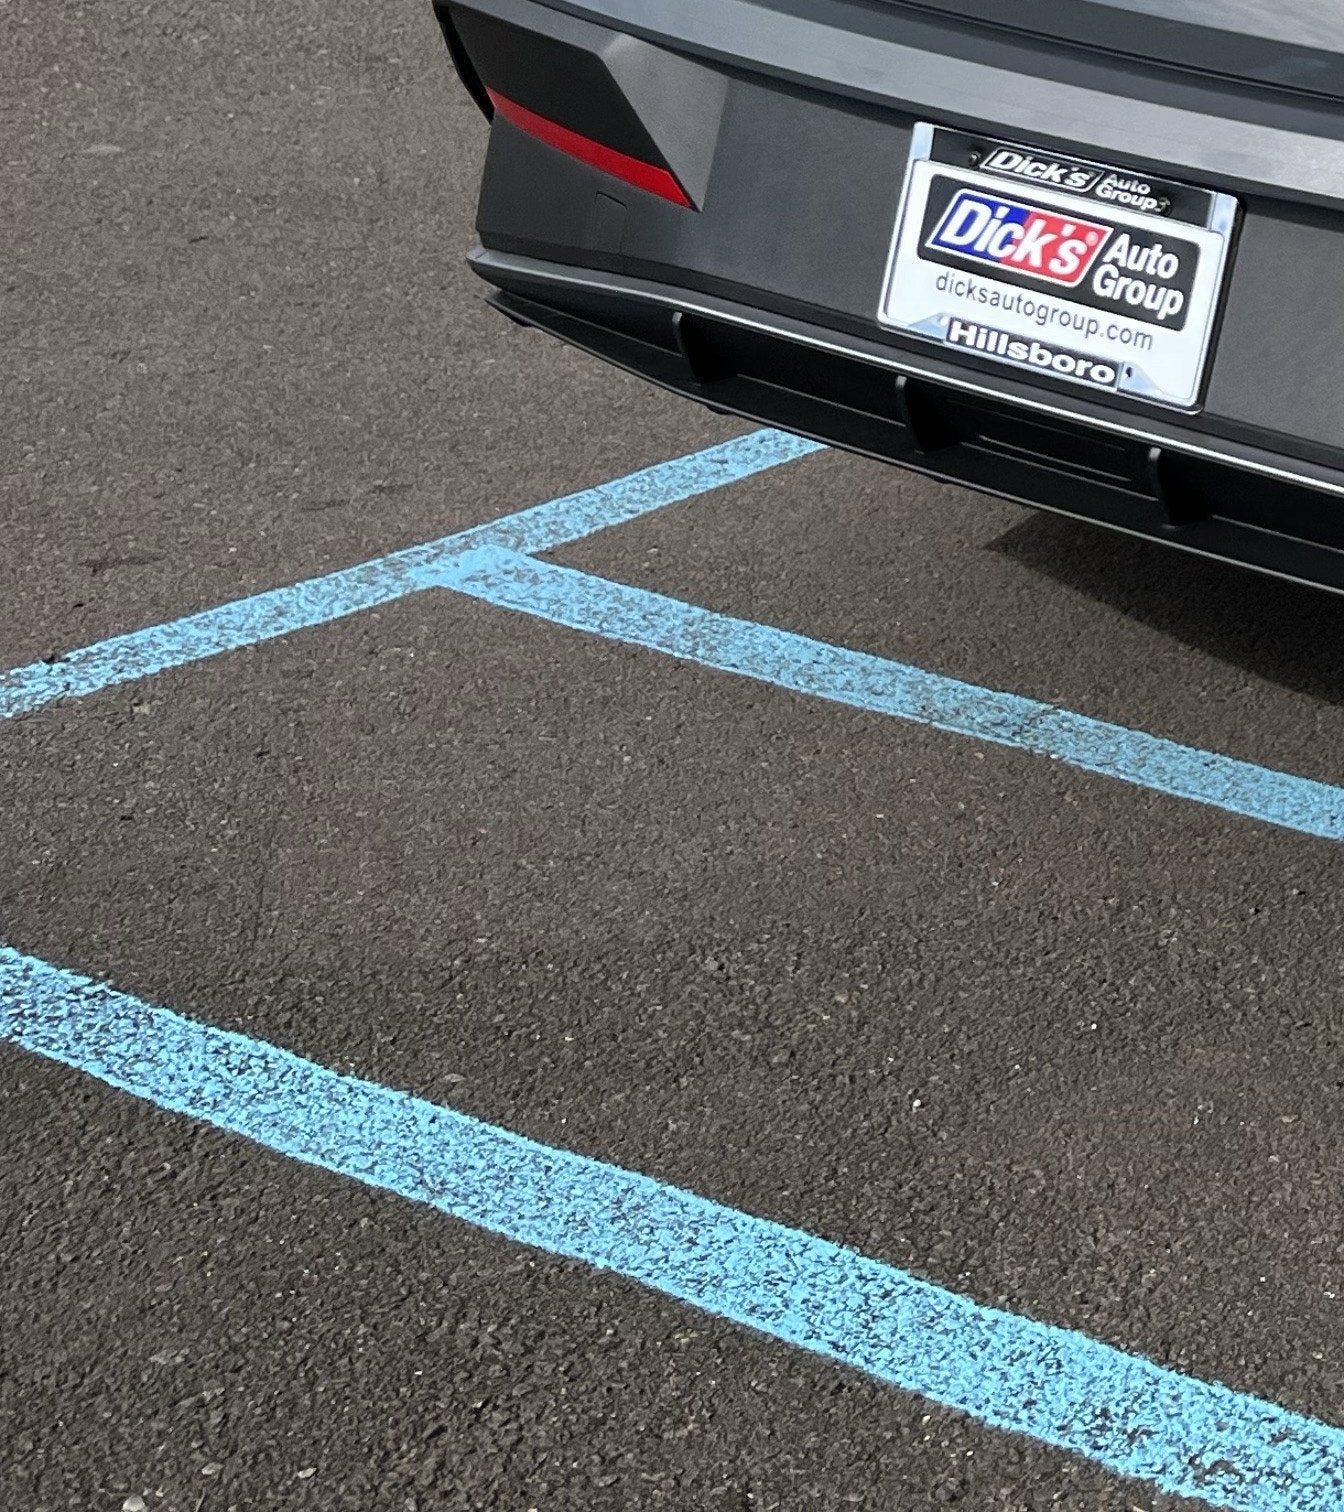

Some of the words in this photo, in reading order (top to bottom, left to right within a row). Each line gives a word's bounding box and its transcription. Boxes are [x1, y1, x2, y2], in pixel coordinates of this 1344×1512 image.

[986, 150, 1092, 189] Dick's
[1100, 172, 1151, 196] Auto
[1095, 183, 1158, 212] Group
[939, 198, 1089, 276] Dick's
[1102, 232, 1179, 280] Auto
[935, 272, 1154, 351] dicksautogroup.com
[1092, 262, 1185, 321] Group
[948, 318, 1117, 385] Hillsboro
